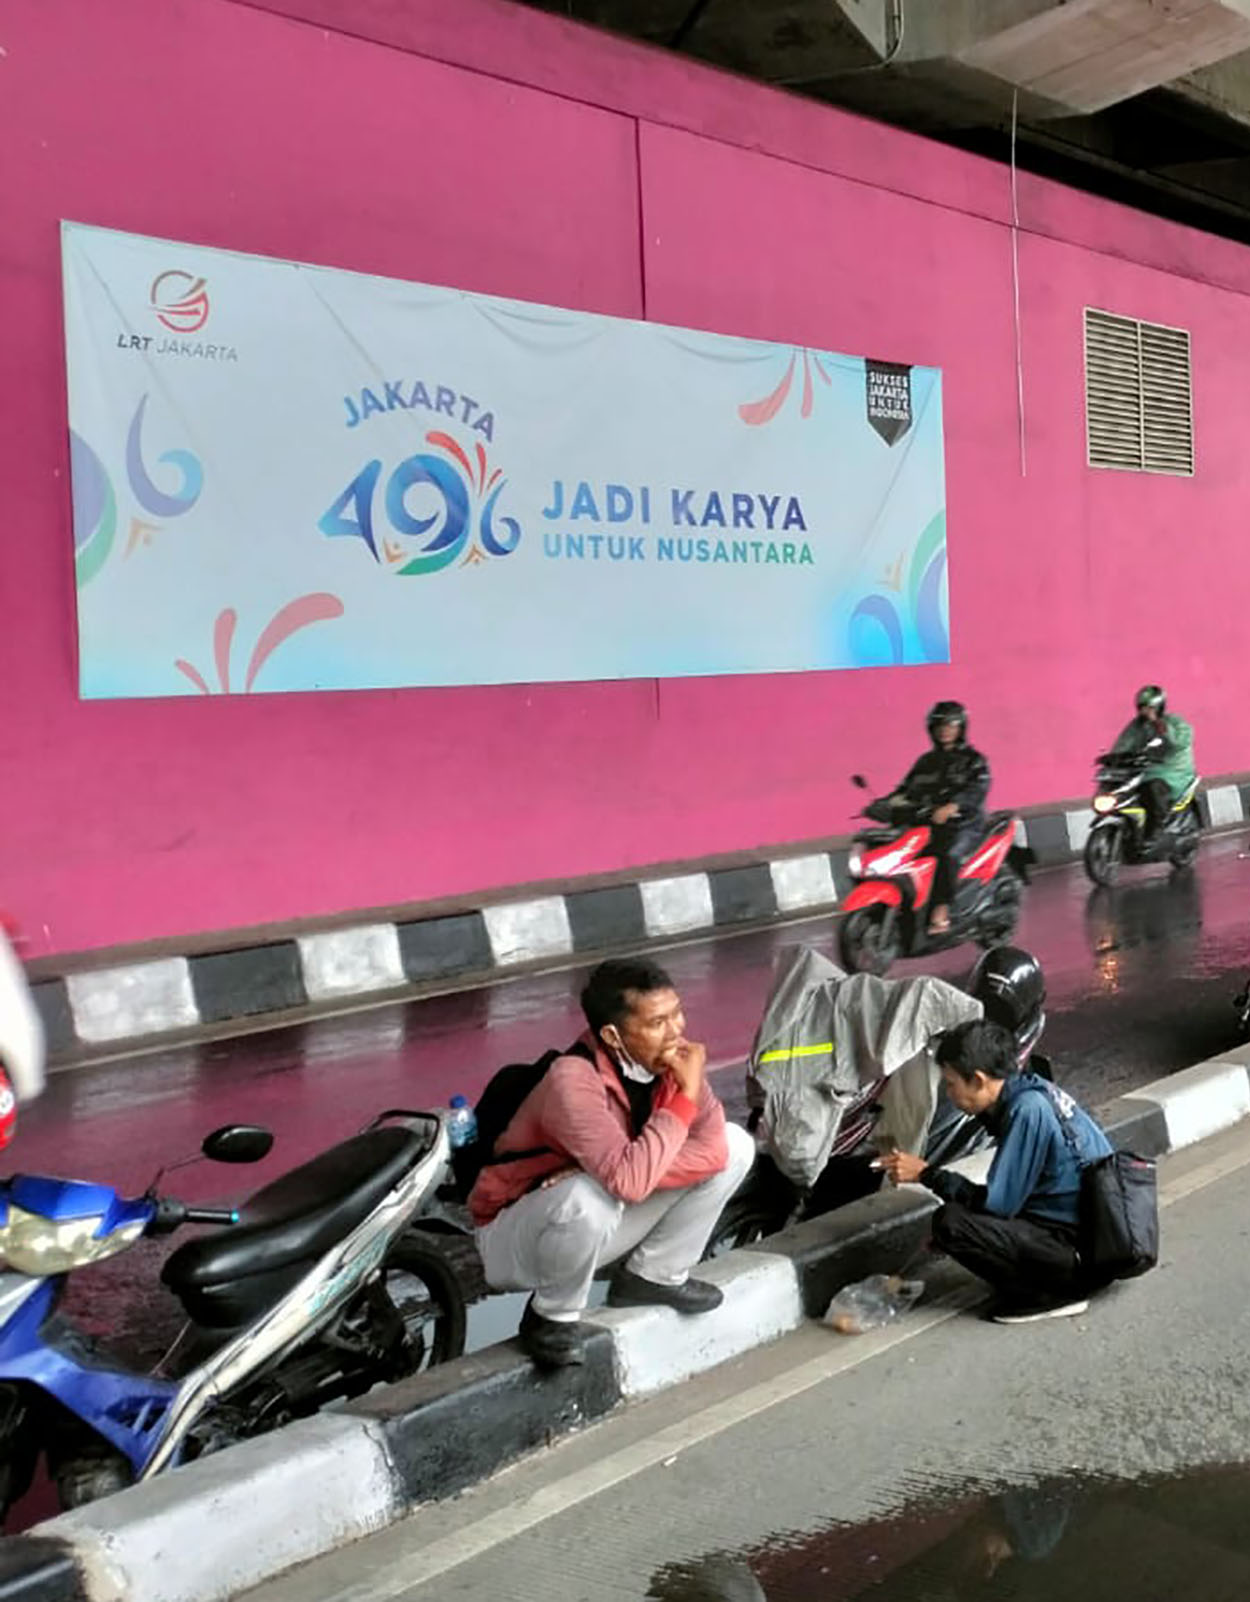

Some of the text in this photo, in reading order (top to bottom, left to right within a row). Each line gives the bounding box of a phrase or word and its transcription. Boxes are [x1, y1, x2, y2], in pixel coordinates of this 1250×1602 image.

[117, 334, 238, 362] LRT JAKARTA
[869, 371, 909, 388] SUKSES
[870, 385, 909, 400] JAKARTA
[343, 380, 496, 443] JAKARTA
[317, 453, 522, 575] 496
[541, 480, 808, 532] JADI KARYA
[543, 533, 815, 565] UNTUK NUSANTARA
